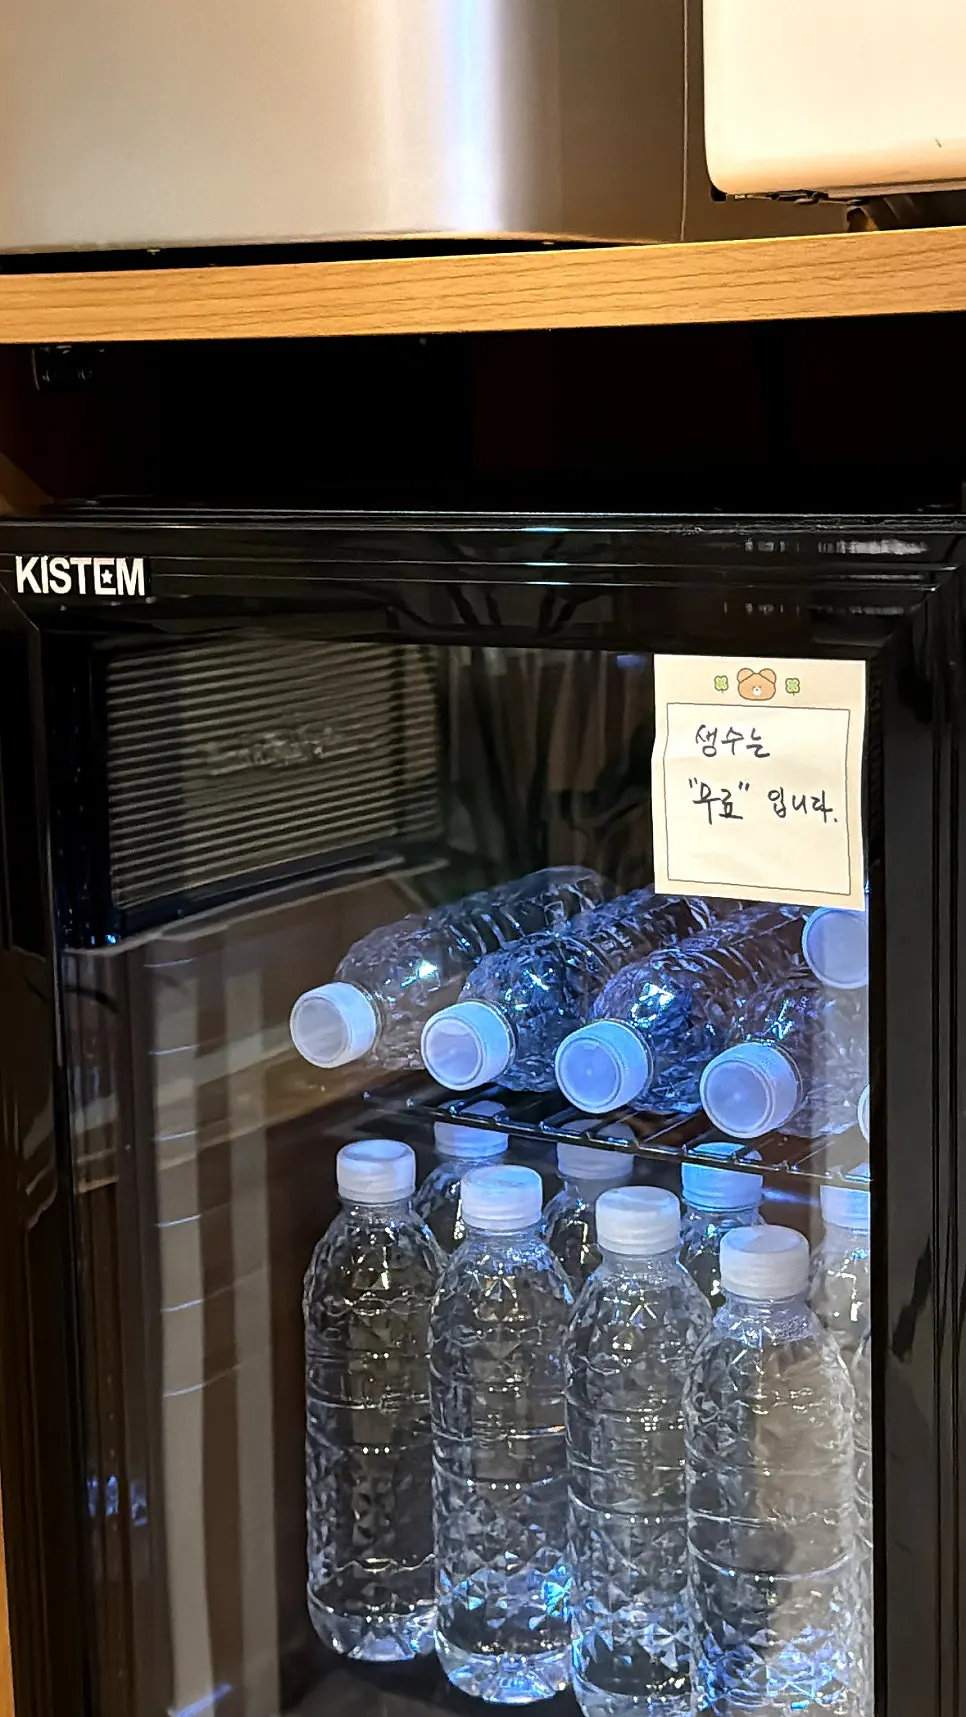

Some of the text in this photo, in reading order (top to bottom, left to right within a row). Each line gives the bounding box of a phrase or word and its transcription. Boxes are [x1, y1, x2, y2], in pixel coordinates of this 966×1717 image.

[15, 555, 146, 597] KISTEM
[695, 724, 771, 759] 생수는
[688, 777, 839, 826] "무료" 입니다.
